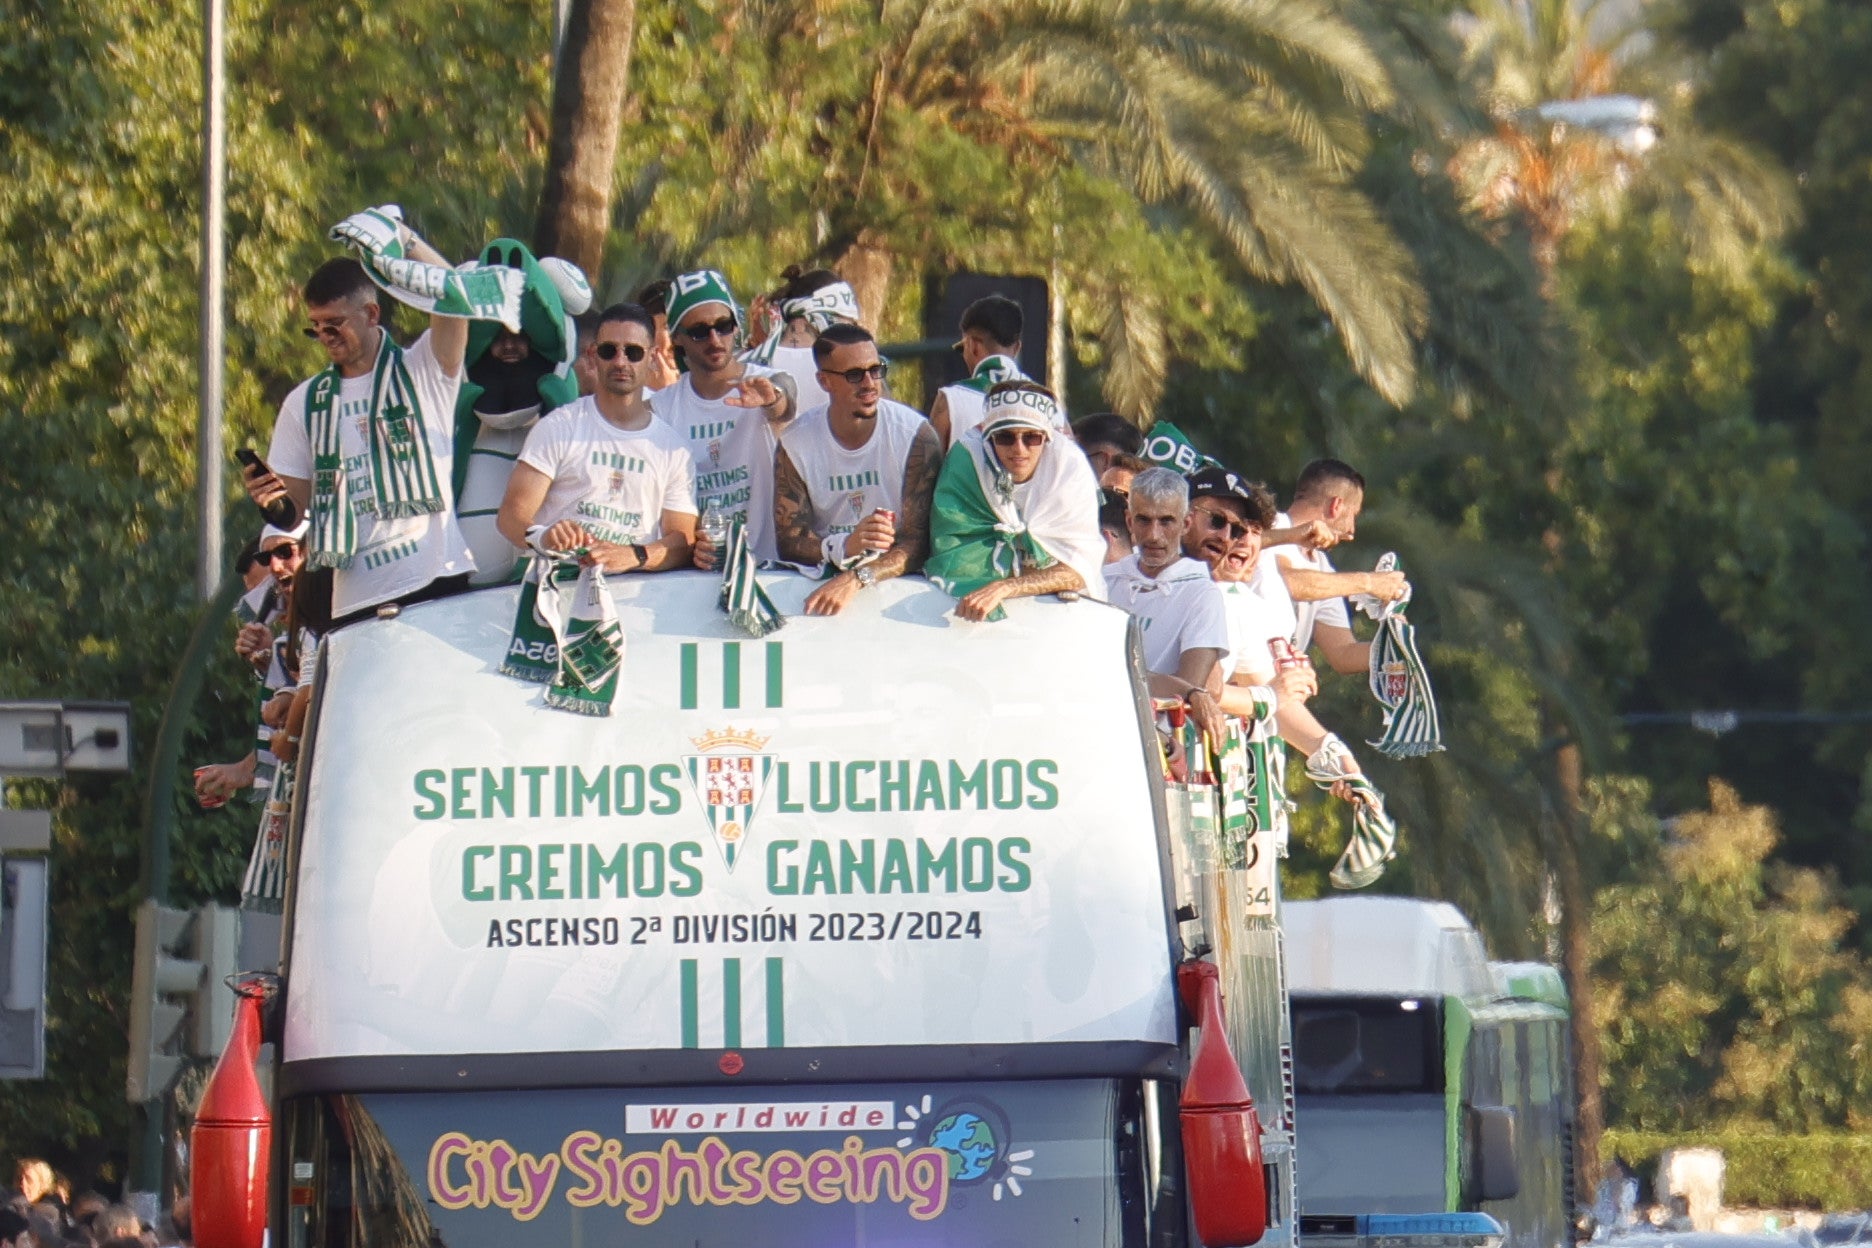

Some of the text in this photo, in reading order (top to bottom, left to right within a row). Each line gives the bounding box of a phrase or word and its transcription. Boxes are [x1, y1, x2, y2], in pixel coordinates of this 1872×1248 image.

[987, 391, 1058, 421] ORDOB
[696, 465, 748, 491] ENTIMOS
[412, 757, 1060, 821] SENTIMOS LUCHAMOS
[461, 836, 1032, 902] CREIMOS GANAMOS
[487, 917, 620, 948] ASCENSO
[672, 907, 798, 945] DIVISIÓN
[808, 910, 983, 943] 2023/2024
[649, 1106, 886, 1131] Worldwide
